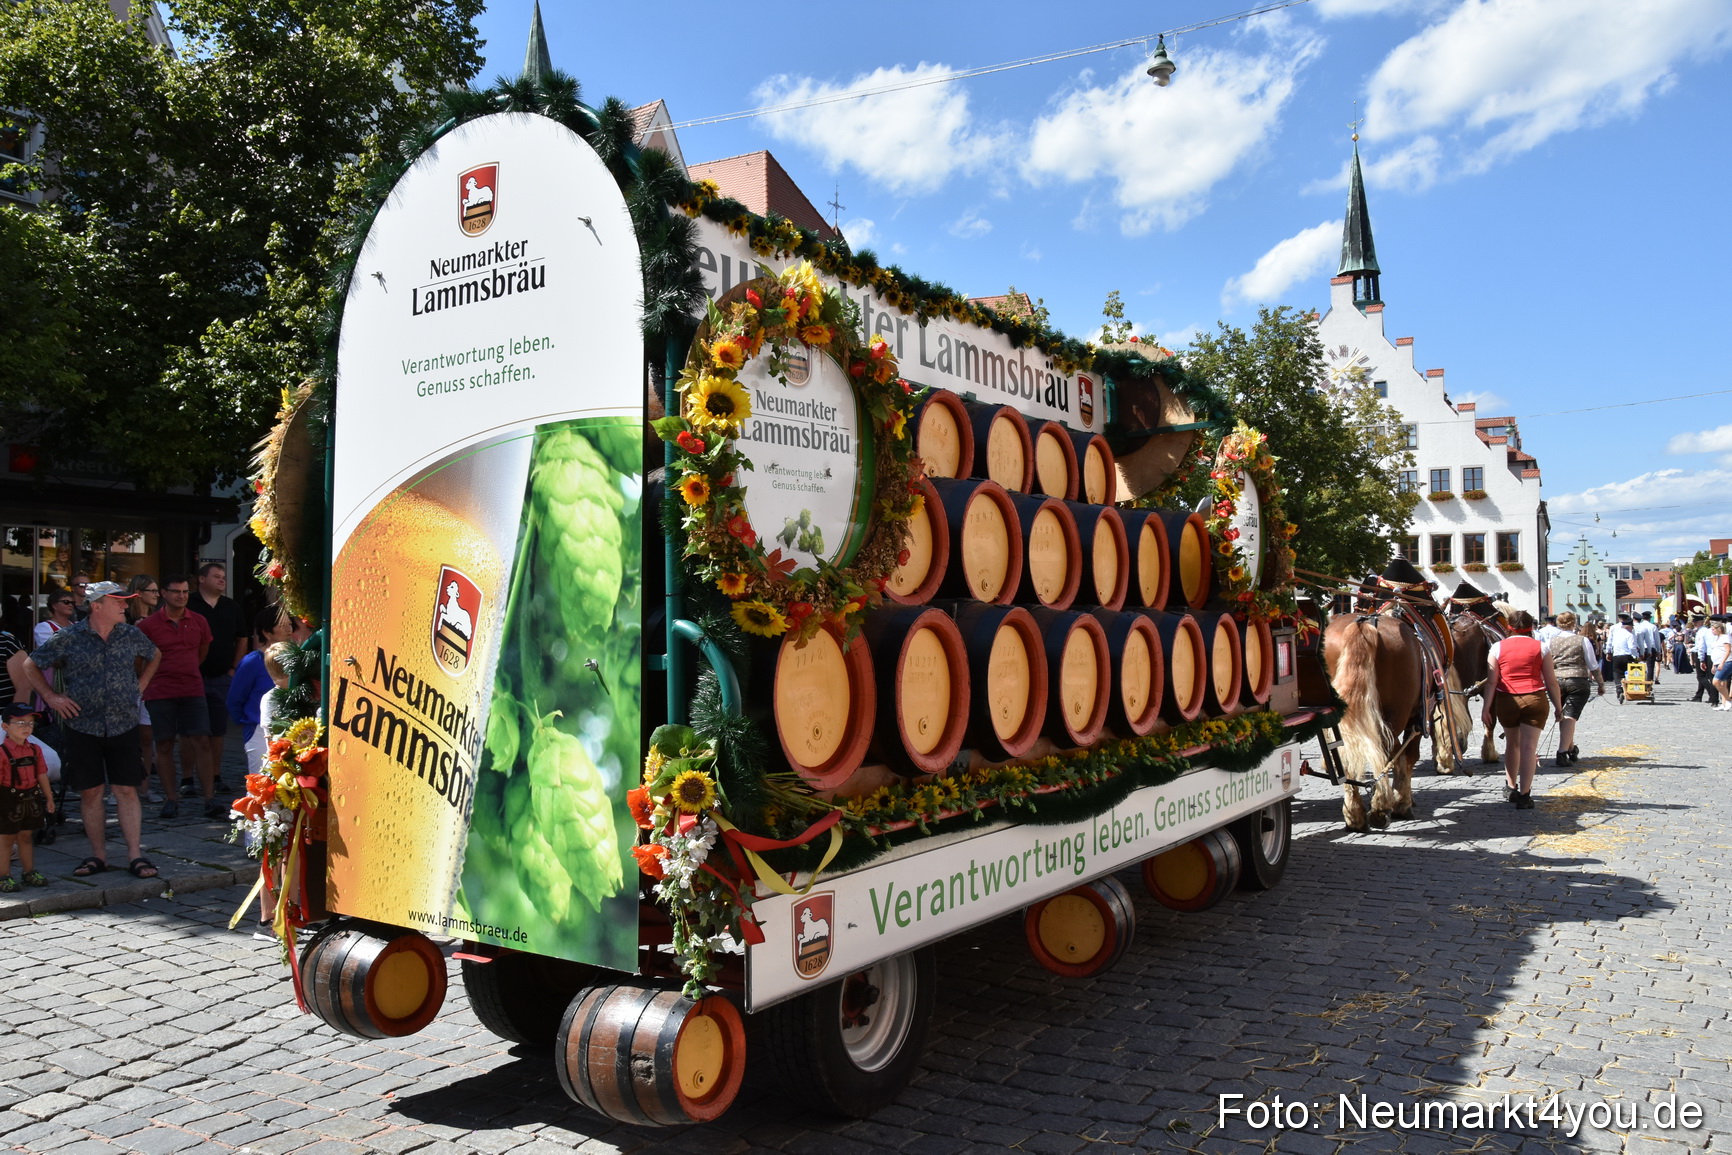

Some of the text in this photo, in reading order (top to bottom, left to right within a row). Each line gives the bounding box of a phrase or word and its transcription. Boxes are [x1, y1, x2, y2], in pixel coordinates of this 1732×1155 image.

[468, 217, 487, 232] 1628
[429, 239, 528, 280] Neumarkter
[412, 261, 546, 316] Lammsbräu
[401, 335, 555, 376] Verantwortung leben.
[919, 322, 1069, 413] Lammsbräu
[416, 365, 536, 398] Genuss schaffen.
[755, 389, 837, 422] Neumarkter
[740, 419, 850, 454] Lammsbräu
[772, 480, 826, 494] Genuss schaffen.
[439, 645, 460, 670] 1628
[869, 768, 1272, 936] Verantwortung leben. Genuss schaffen.
[408, 908, 528, 944] www.lammsbraeu.de
[803, 956, 824, 975] 1628
